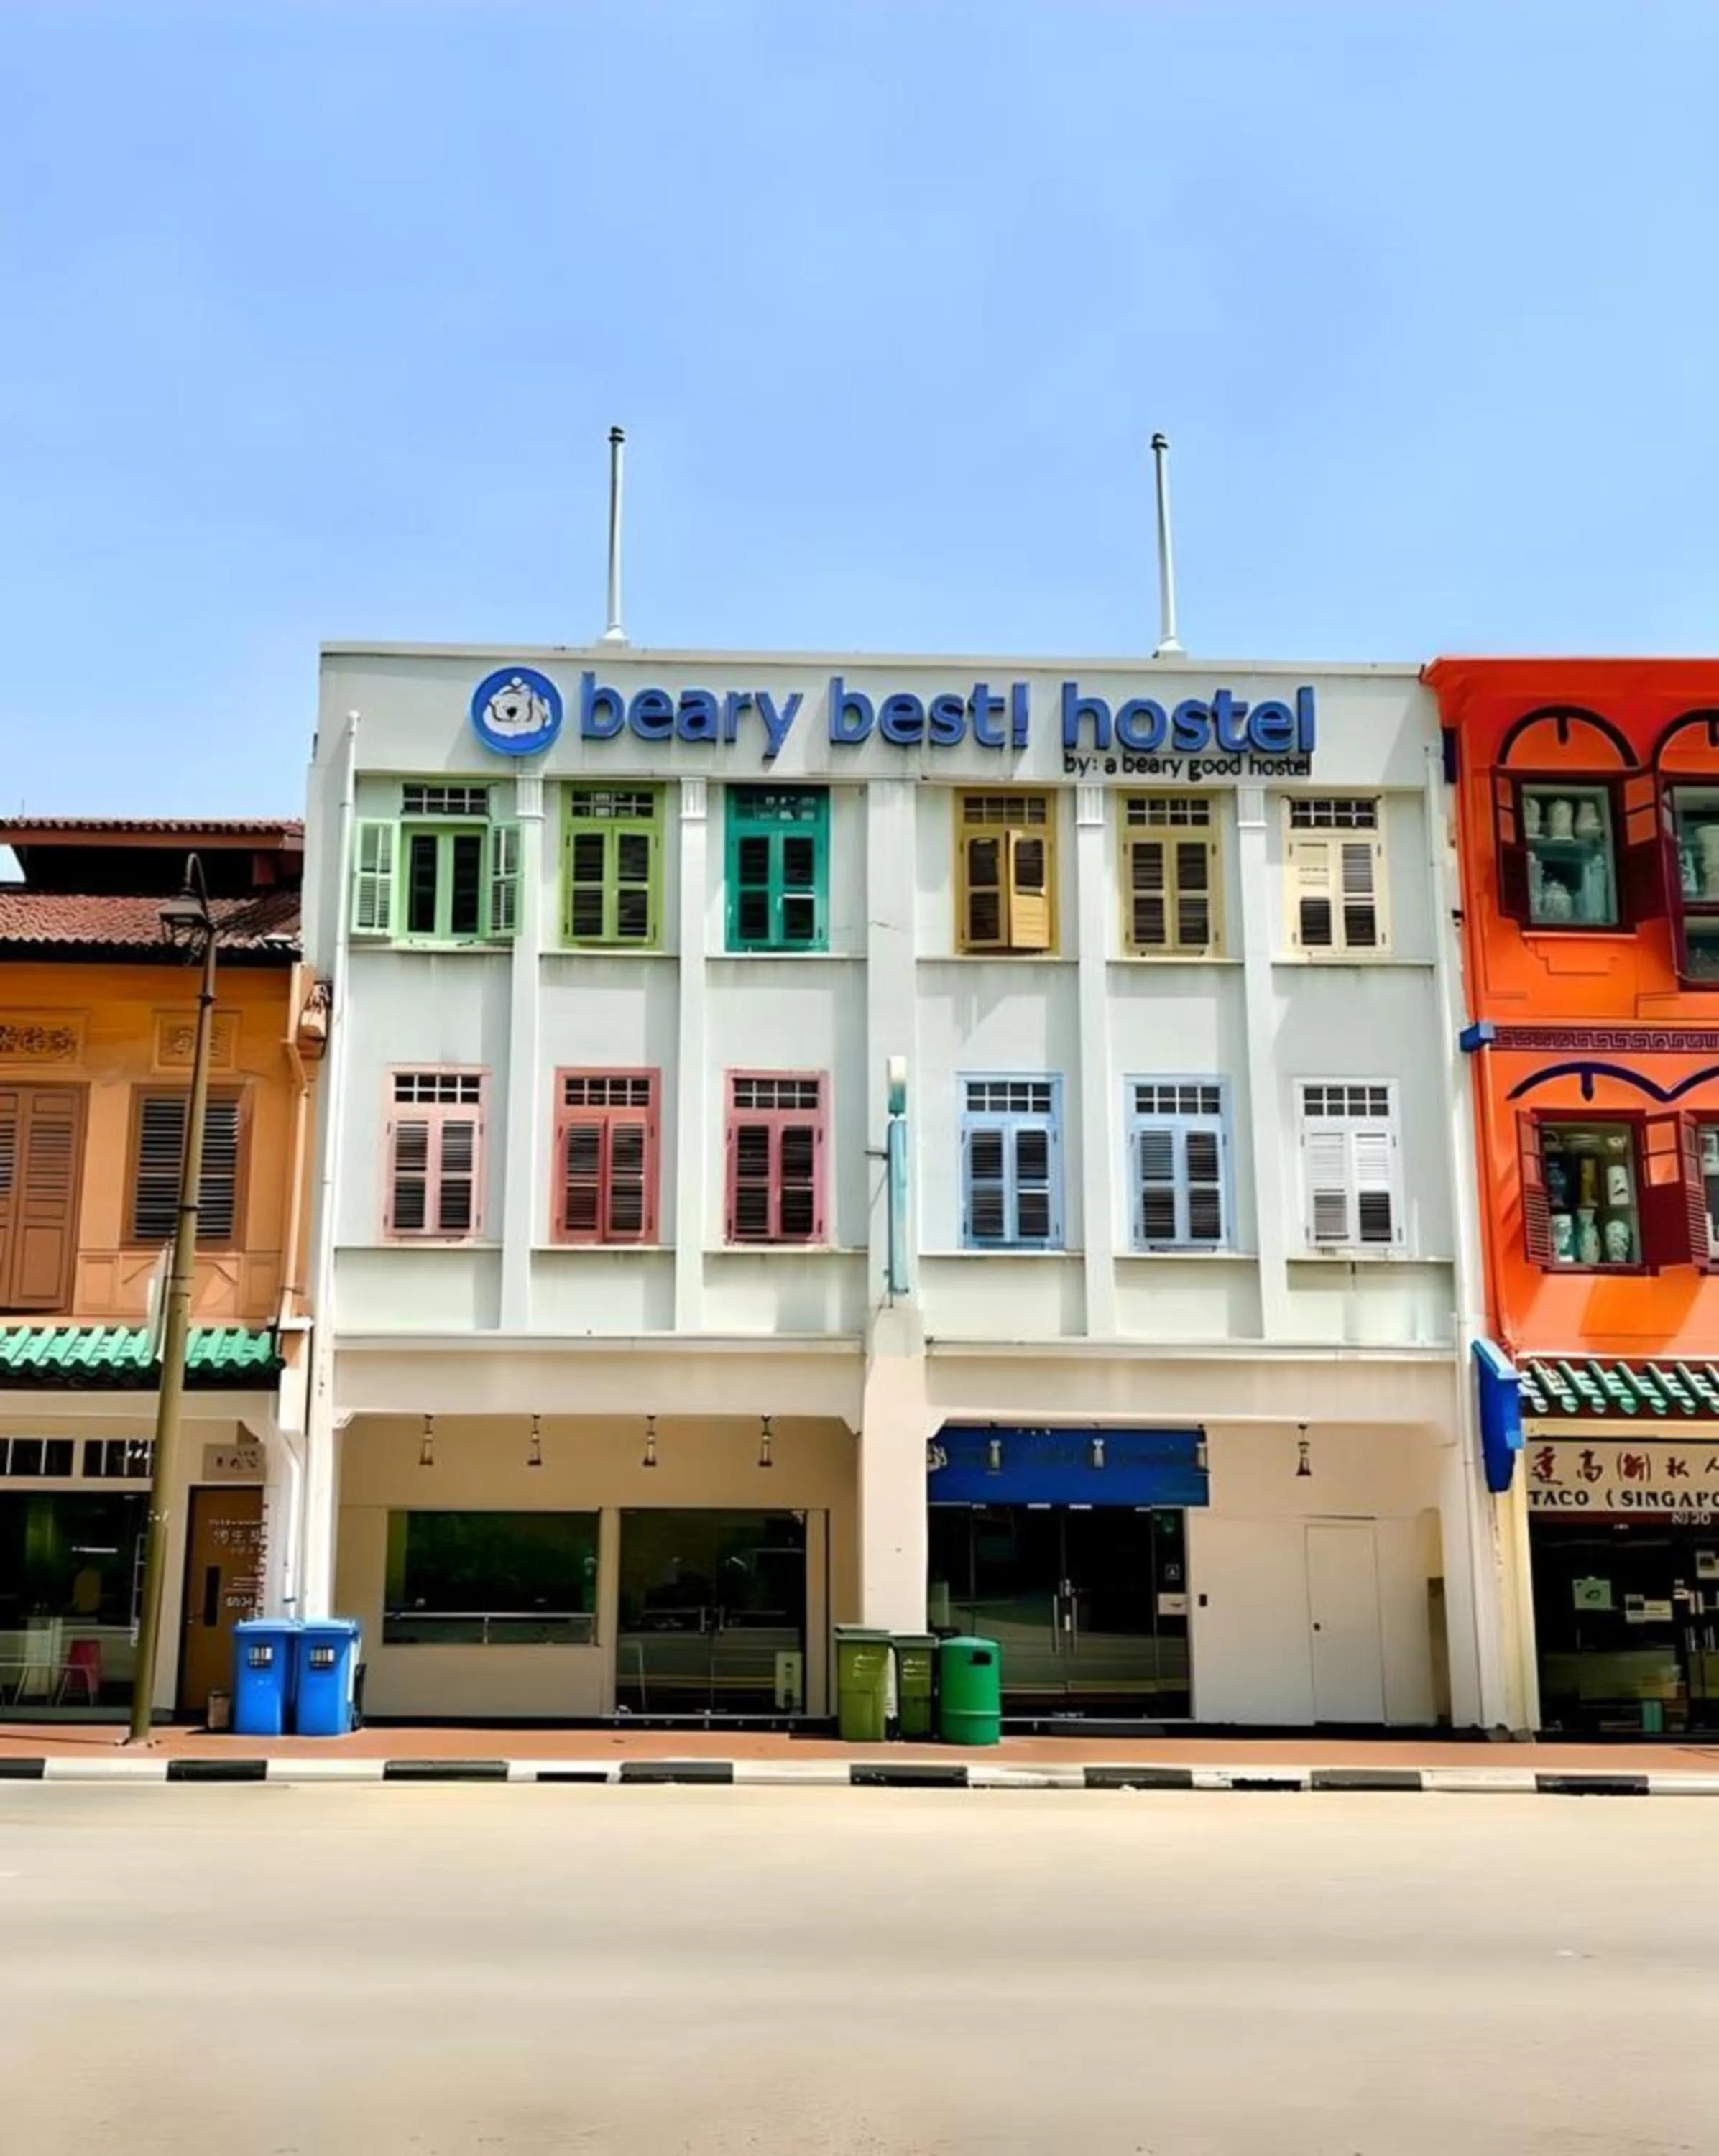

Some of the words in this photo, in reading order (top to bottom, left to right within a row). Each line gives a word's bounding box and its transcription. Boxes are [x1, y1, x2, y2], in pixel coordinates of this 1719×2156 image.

[580, 671, 805, 760] beary
[829, 676, 1029, 749] best!
[1061, 682, 1315, 753] hostel
[1063, 755, 1098, 778] by:
[1105, 759, 1117, 774] a
[1123, 753, 1182, 778] beary
[1188, 755, 1242, 781] good
[1249, 753, 1312, 776] hostel
[1528, 1491, 1590, 1506] TACO
